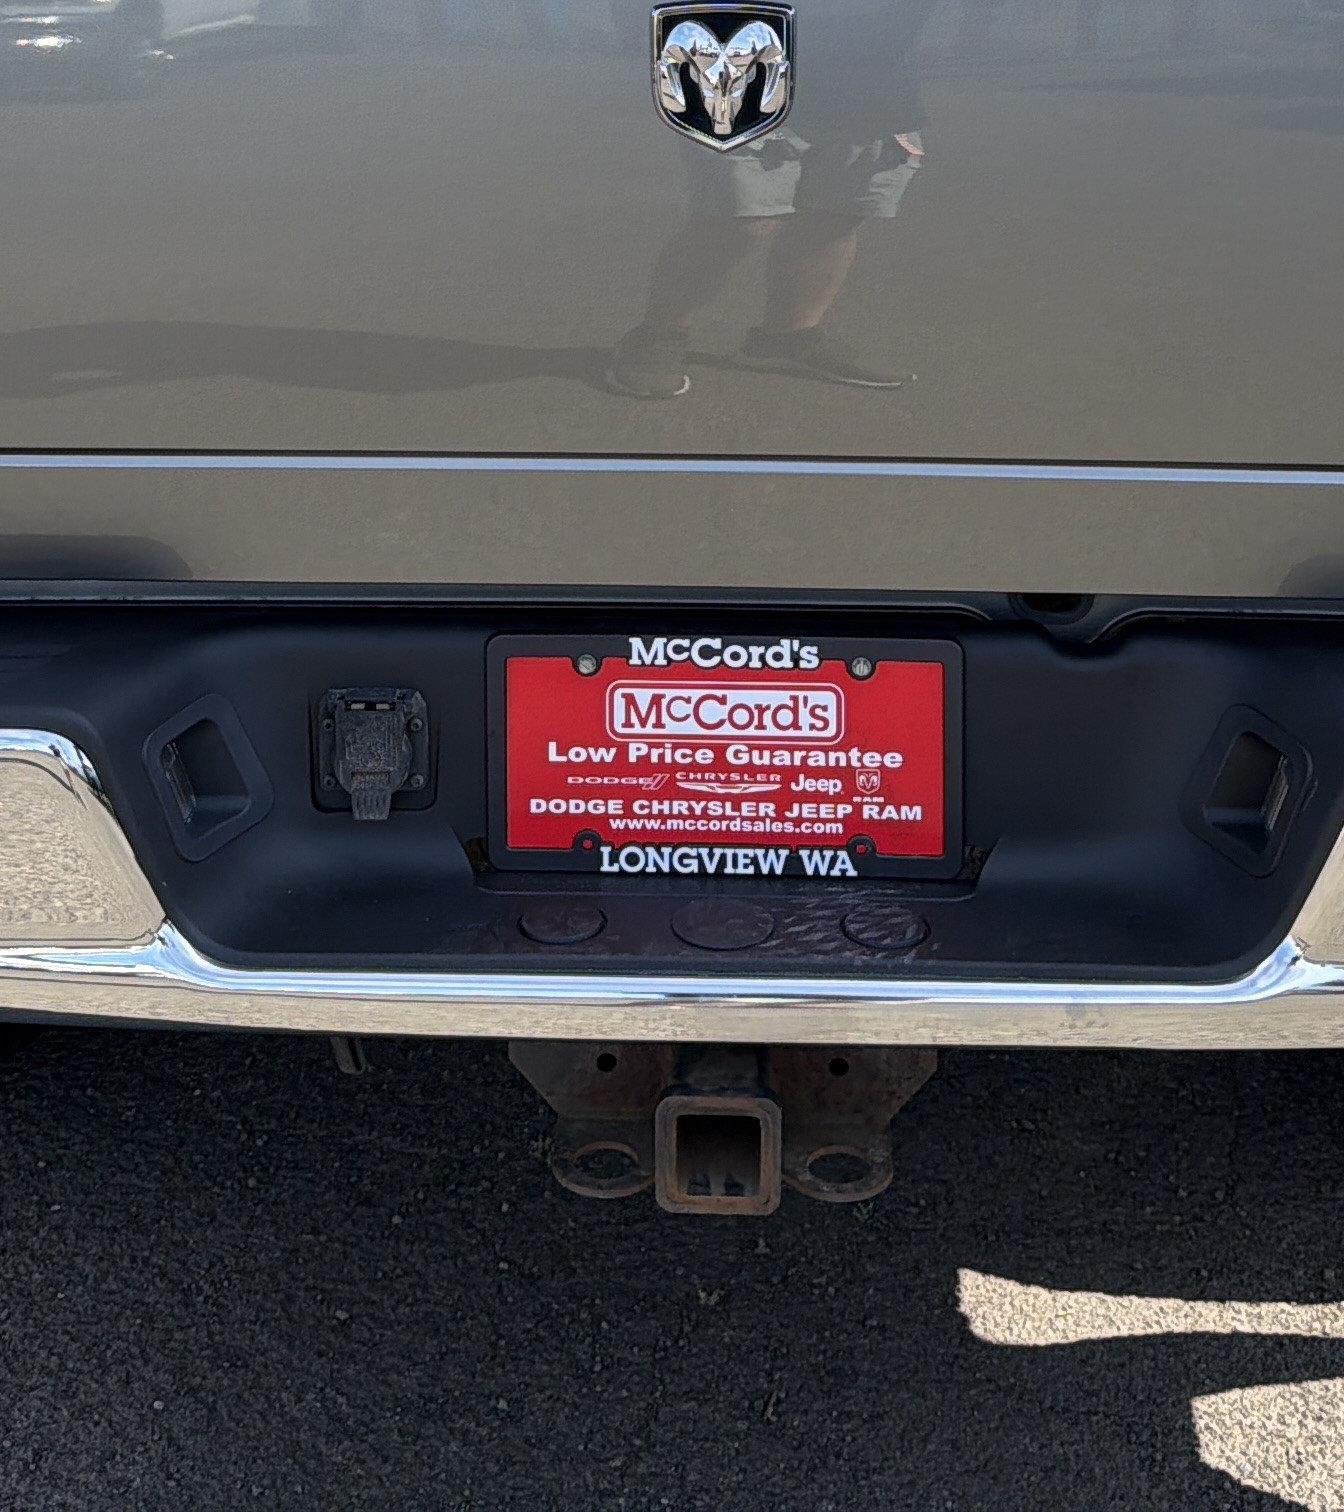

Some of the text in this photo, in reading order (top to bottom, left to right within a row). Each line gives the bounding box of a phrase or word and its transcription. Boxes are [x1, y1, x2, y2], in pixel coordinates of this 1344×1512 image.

[628, 637, 820, 669] McCord's
[620, 692, 831, 732] McCord's
[548, 741, 904, 768] Low Price Guarantee
[567, 771, 843, 795] DODGE CHRYSLER Jeep
[530, 798, 923, 821] DODGE CHRYSLER JEEP RAM
[608, 817, 844, 834] www.mccordsales.com
[599, 845, 858, 877] LONGVIEW WA
